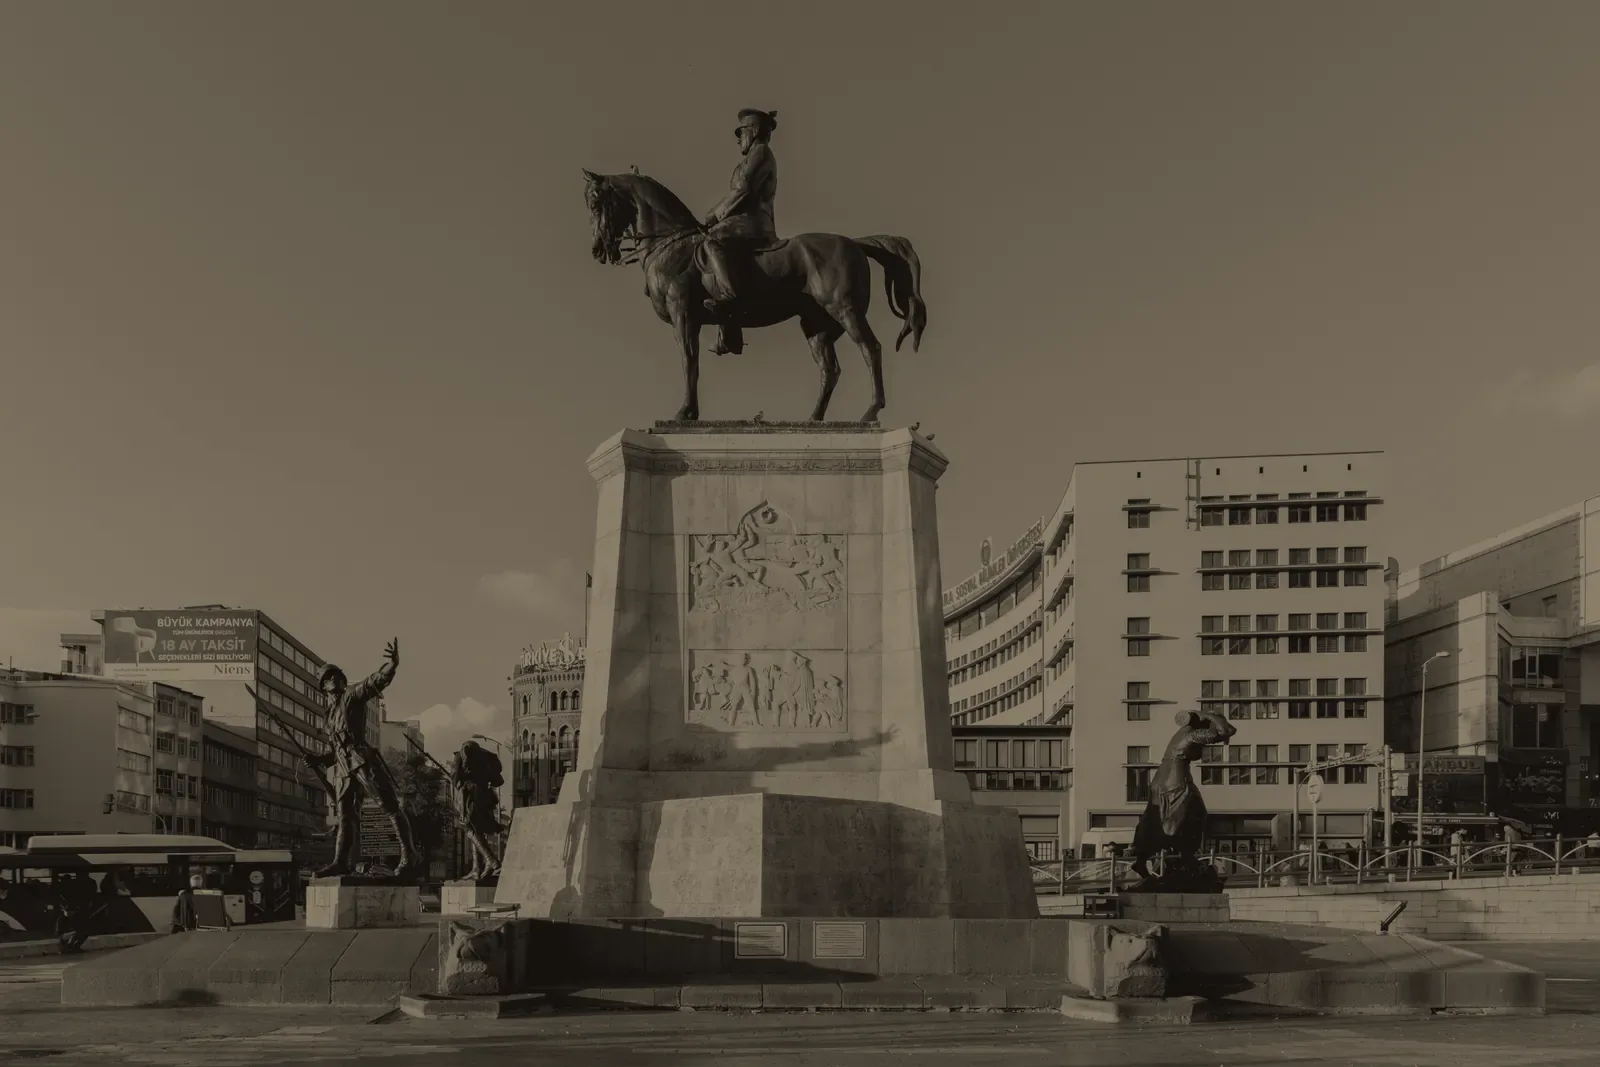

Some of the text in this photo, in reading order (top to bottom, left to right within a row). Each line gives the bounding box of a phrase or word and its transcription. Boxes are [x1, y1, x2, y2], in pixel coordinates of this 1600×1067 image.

[157, 616, 254, 627] BÜYÜK KAMPANYA
[160, 636, 246, 651] 18 AY TAKSİT
[158, 653, 251, 662] SEÇENEKLERİ SİZİ BEKLİYOR!
[214, 663, 251, 675] Niens
